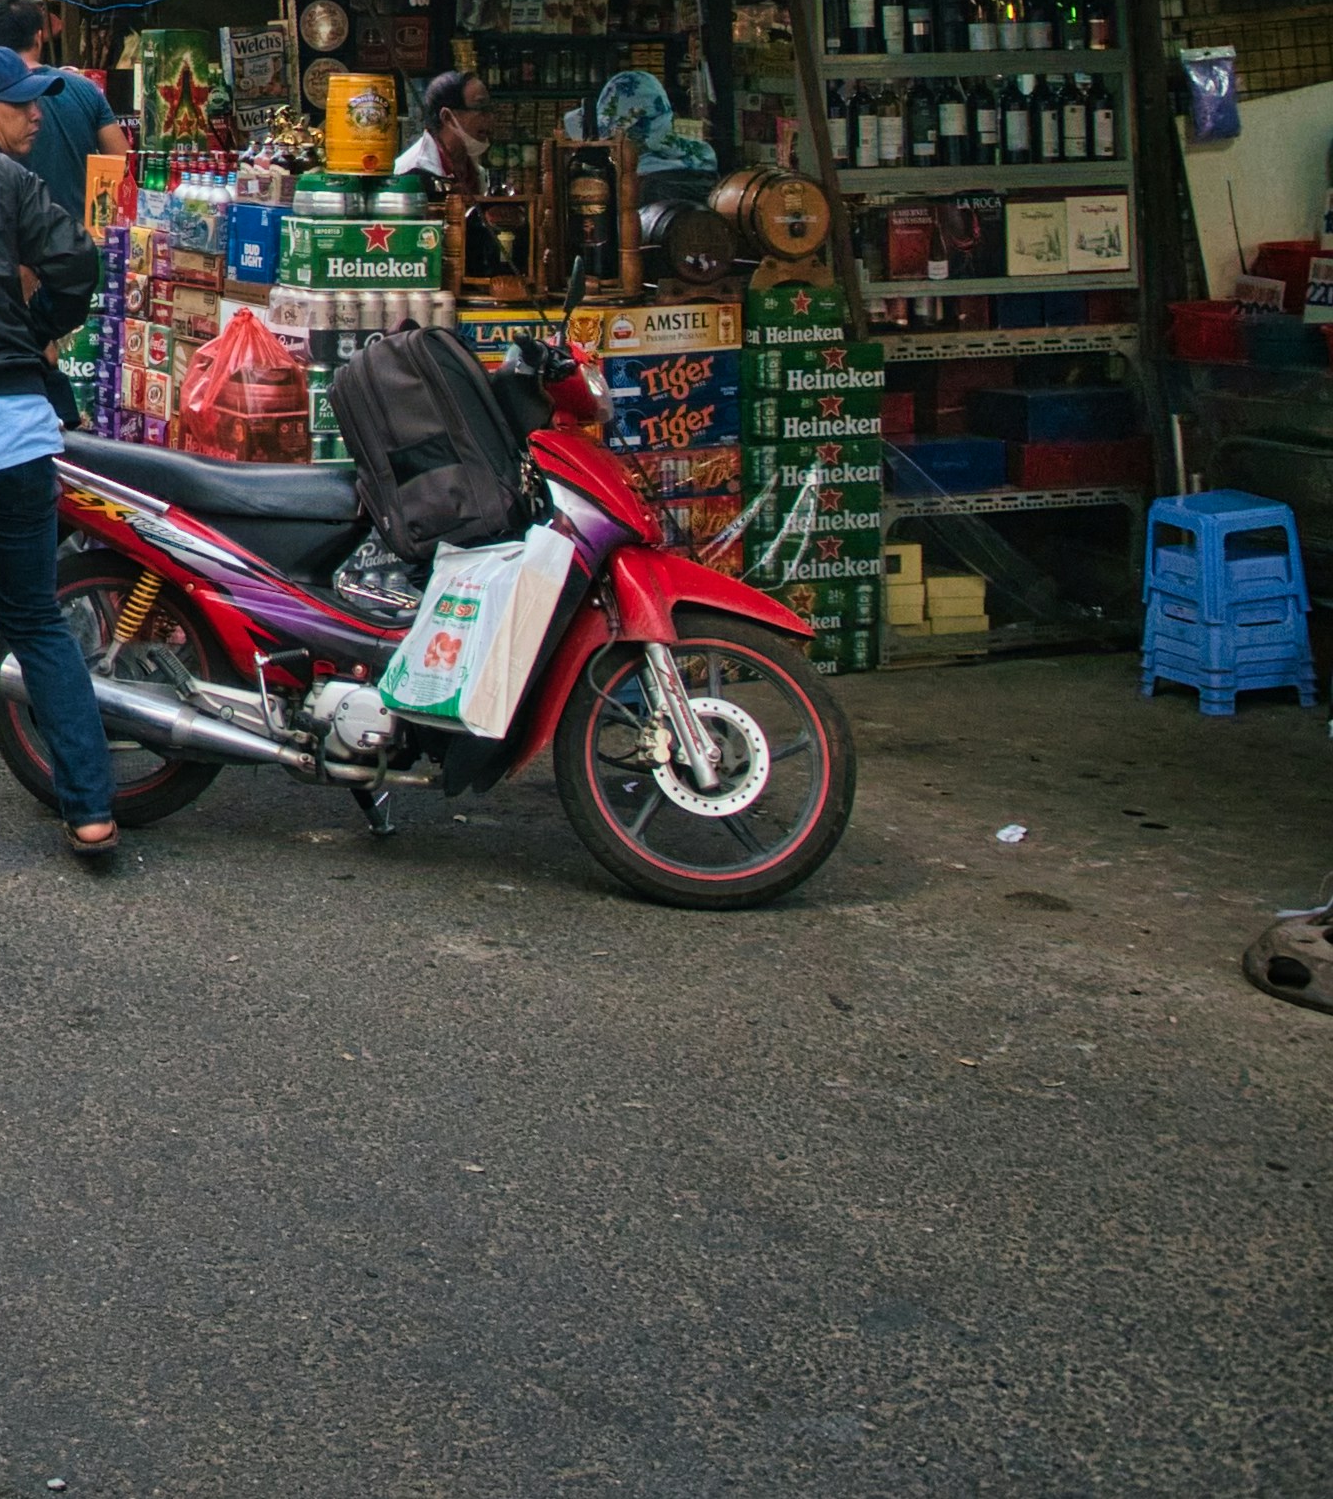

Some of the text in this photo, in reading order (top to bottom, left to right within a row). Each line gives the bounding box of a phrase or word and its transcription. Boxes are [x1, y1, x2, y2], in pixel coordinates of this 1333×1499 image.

[233, 33, 282, 56] Welch's
[956, 197, 1002, 210] LA ROCA
[244, 243, 261, 255] BUD
[240, 255, 263, 269] LIGHT
[327, 256, 428, 278] Heineken
[644, 312, 710, 332] AMSTEL
[765, 325, 844, 345] Heineken
[640, 355, 714, 400] Tiger
[787, 367, 885, 391] Heineken
[640, 403, 715, 448] Tiger
[783, 414, 882, 438] Heineken
